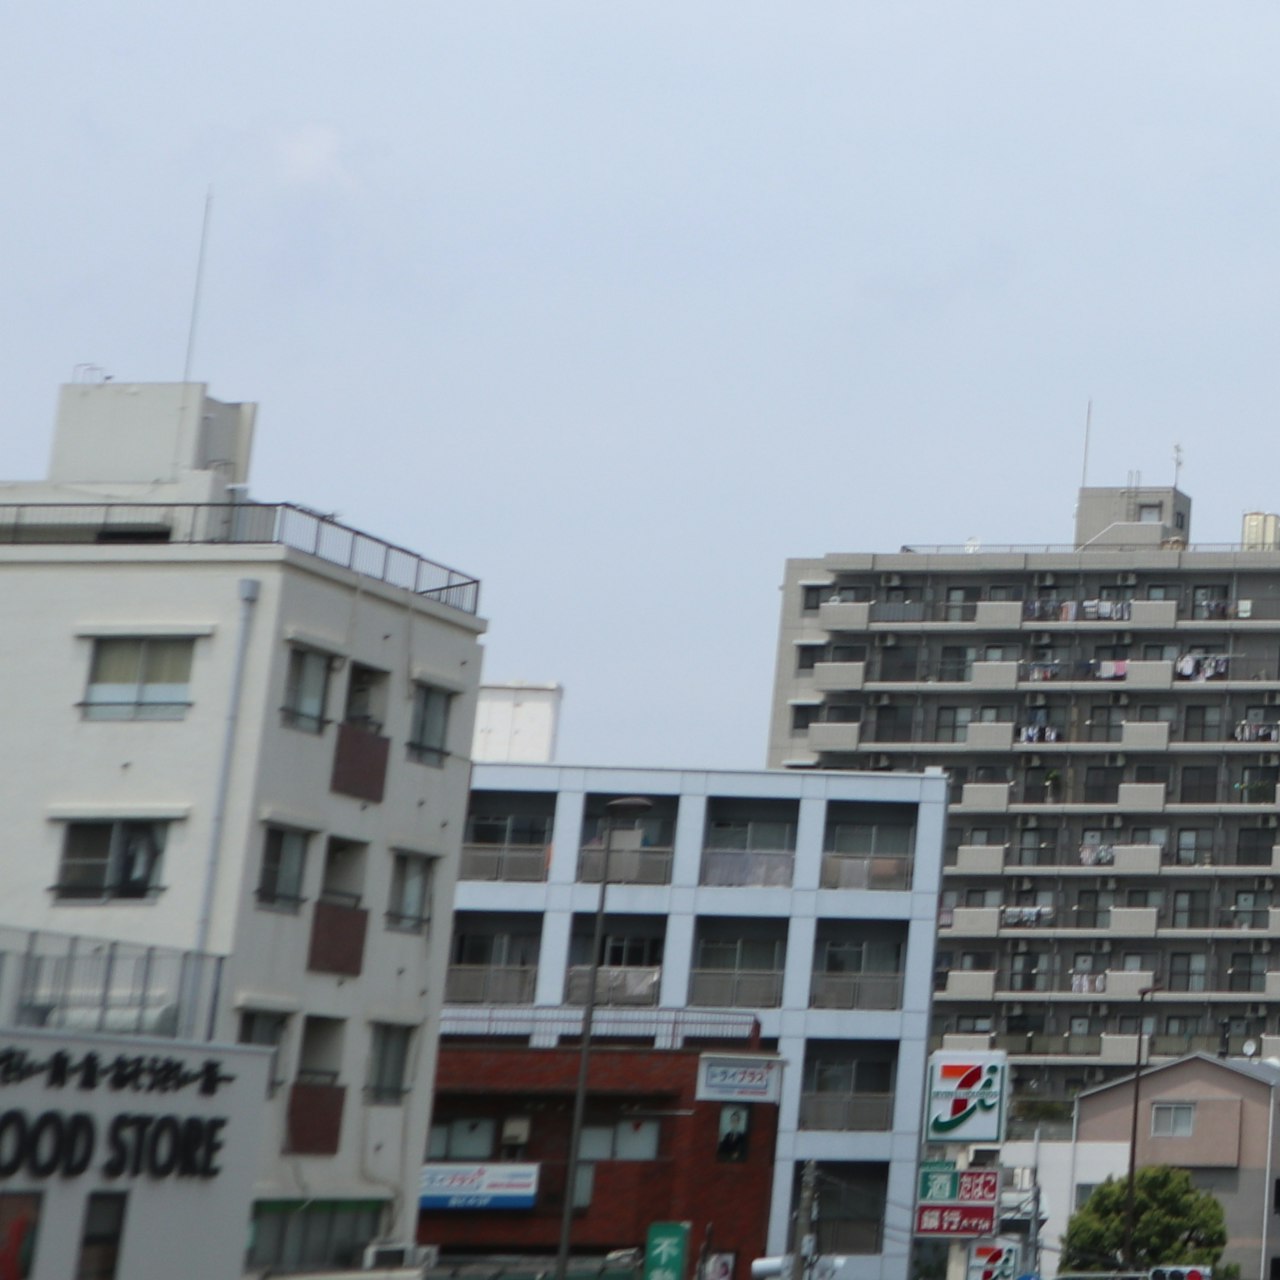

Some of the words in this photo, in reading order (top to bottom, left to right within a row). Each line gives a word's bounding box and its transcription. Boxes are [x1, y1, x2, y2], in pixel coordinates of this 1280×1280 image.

[102, 1112, 230, 1180] STORE
[926, 1173, 954, 1200] 酒
[959, 1173, 996, 1200] たばこ
